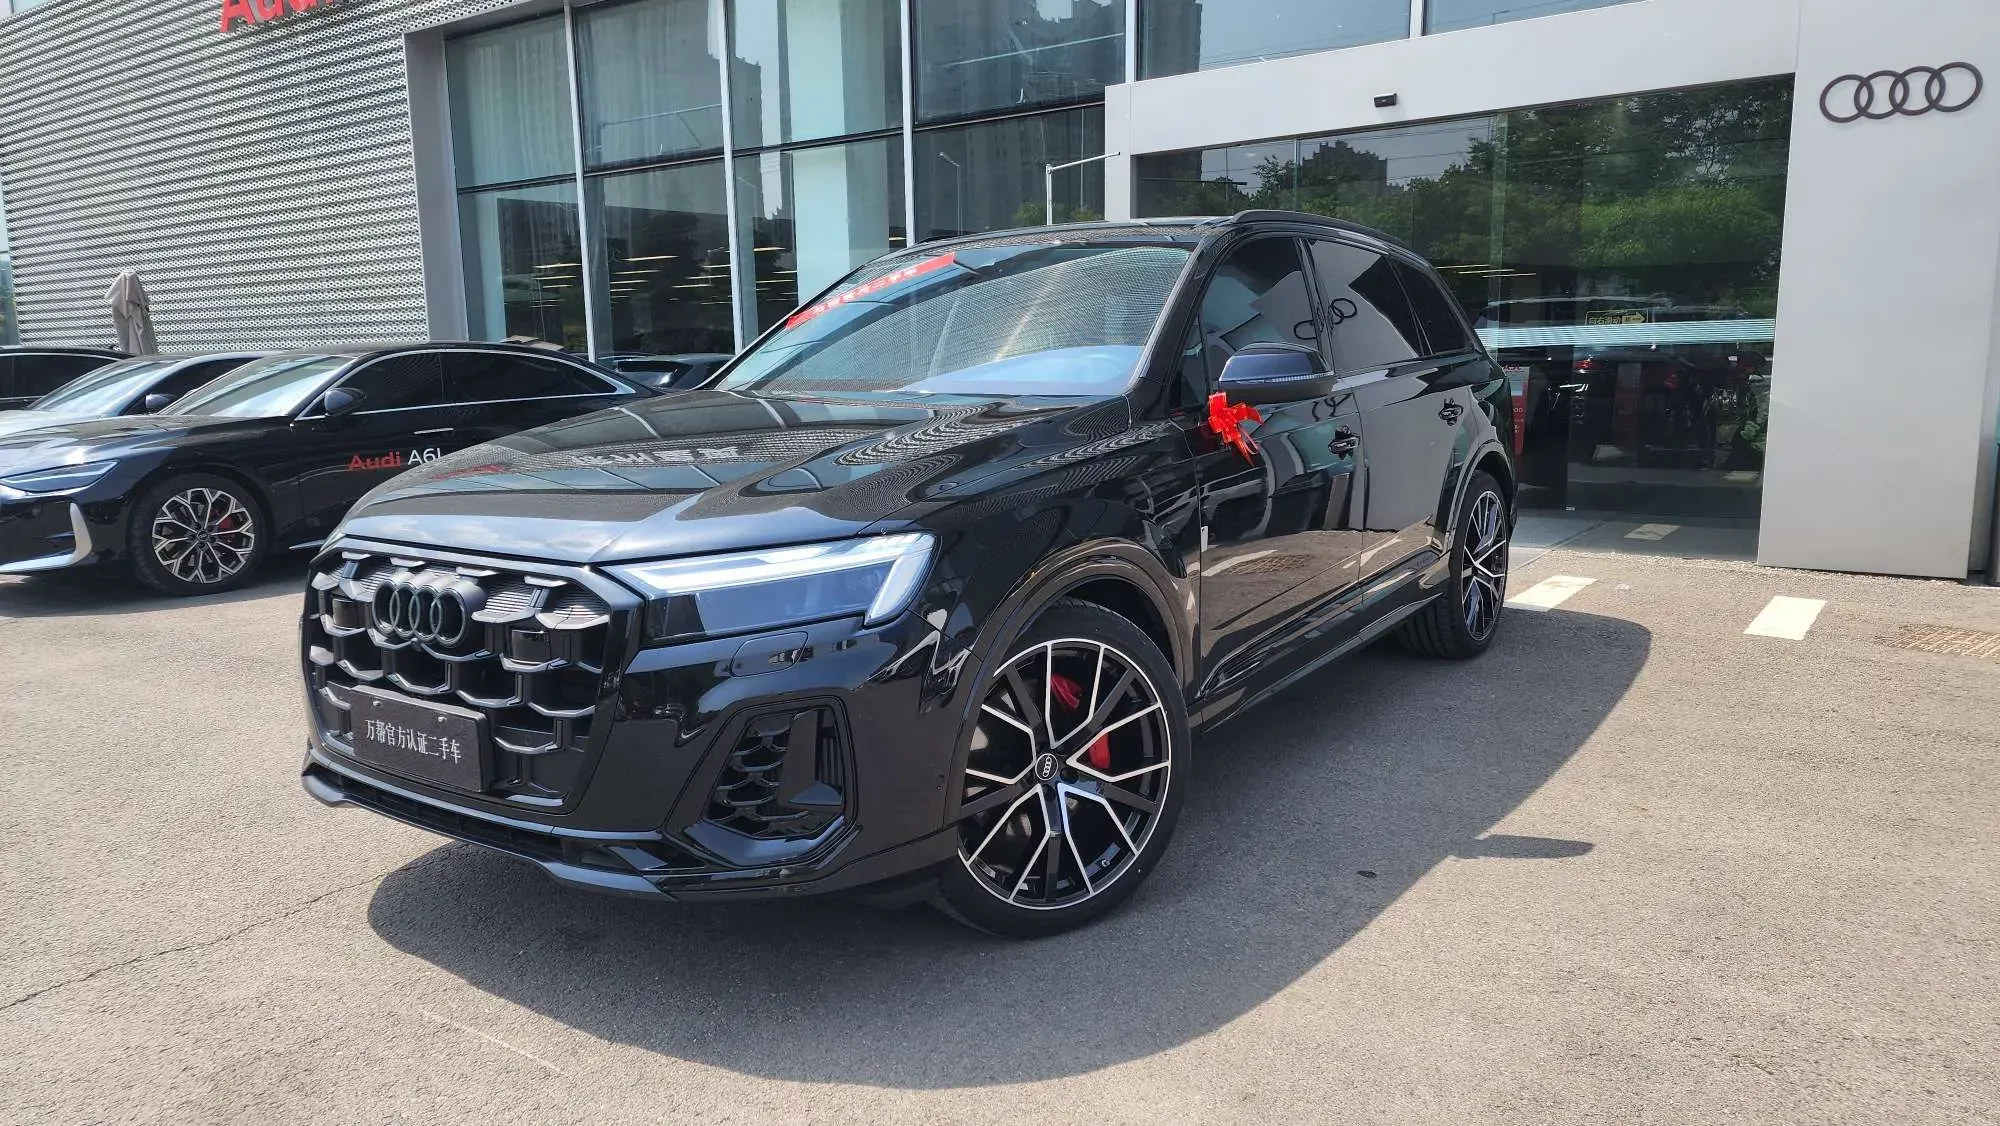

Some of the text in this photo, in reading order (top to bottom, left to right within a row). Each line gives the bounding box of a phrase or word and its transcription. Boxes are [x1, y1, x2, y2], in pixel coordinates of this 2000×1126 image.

[220, 0, 334, 33] Au
[348, 449, 401, 470] Audi
[364, 719, 462, 764] 万帮官方认证二手车
